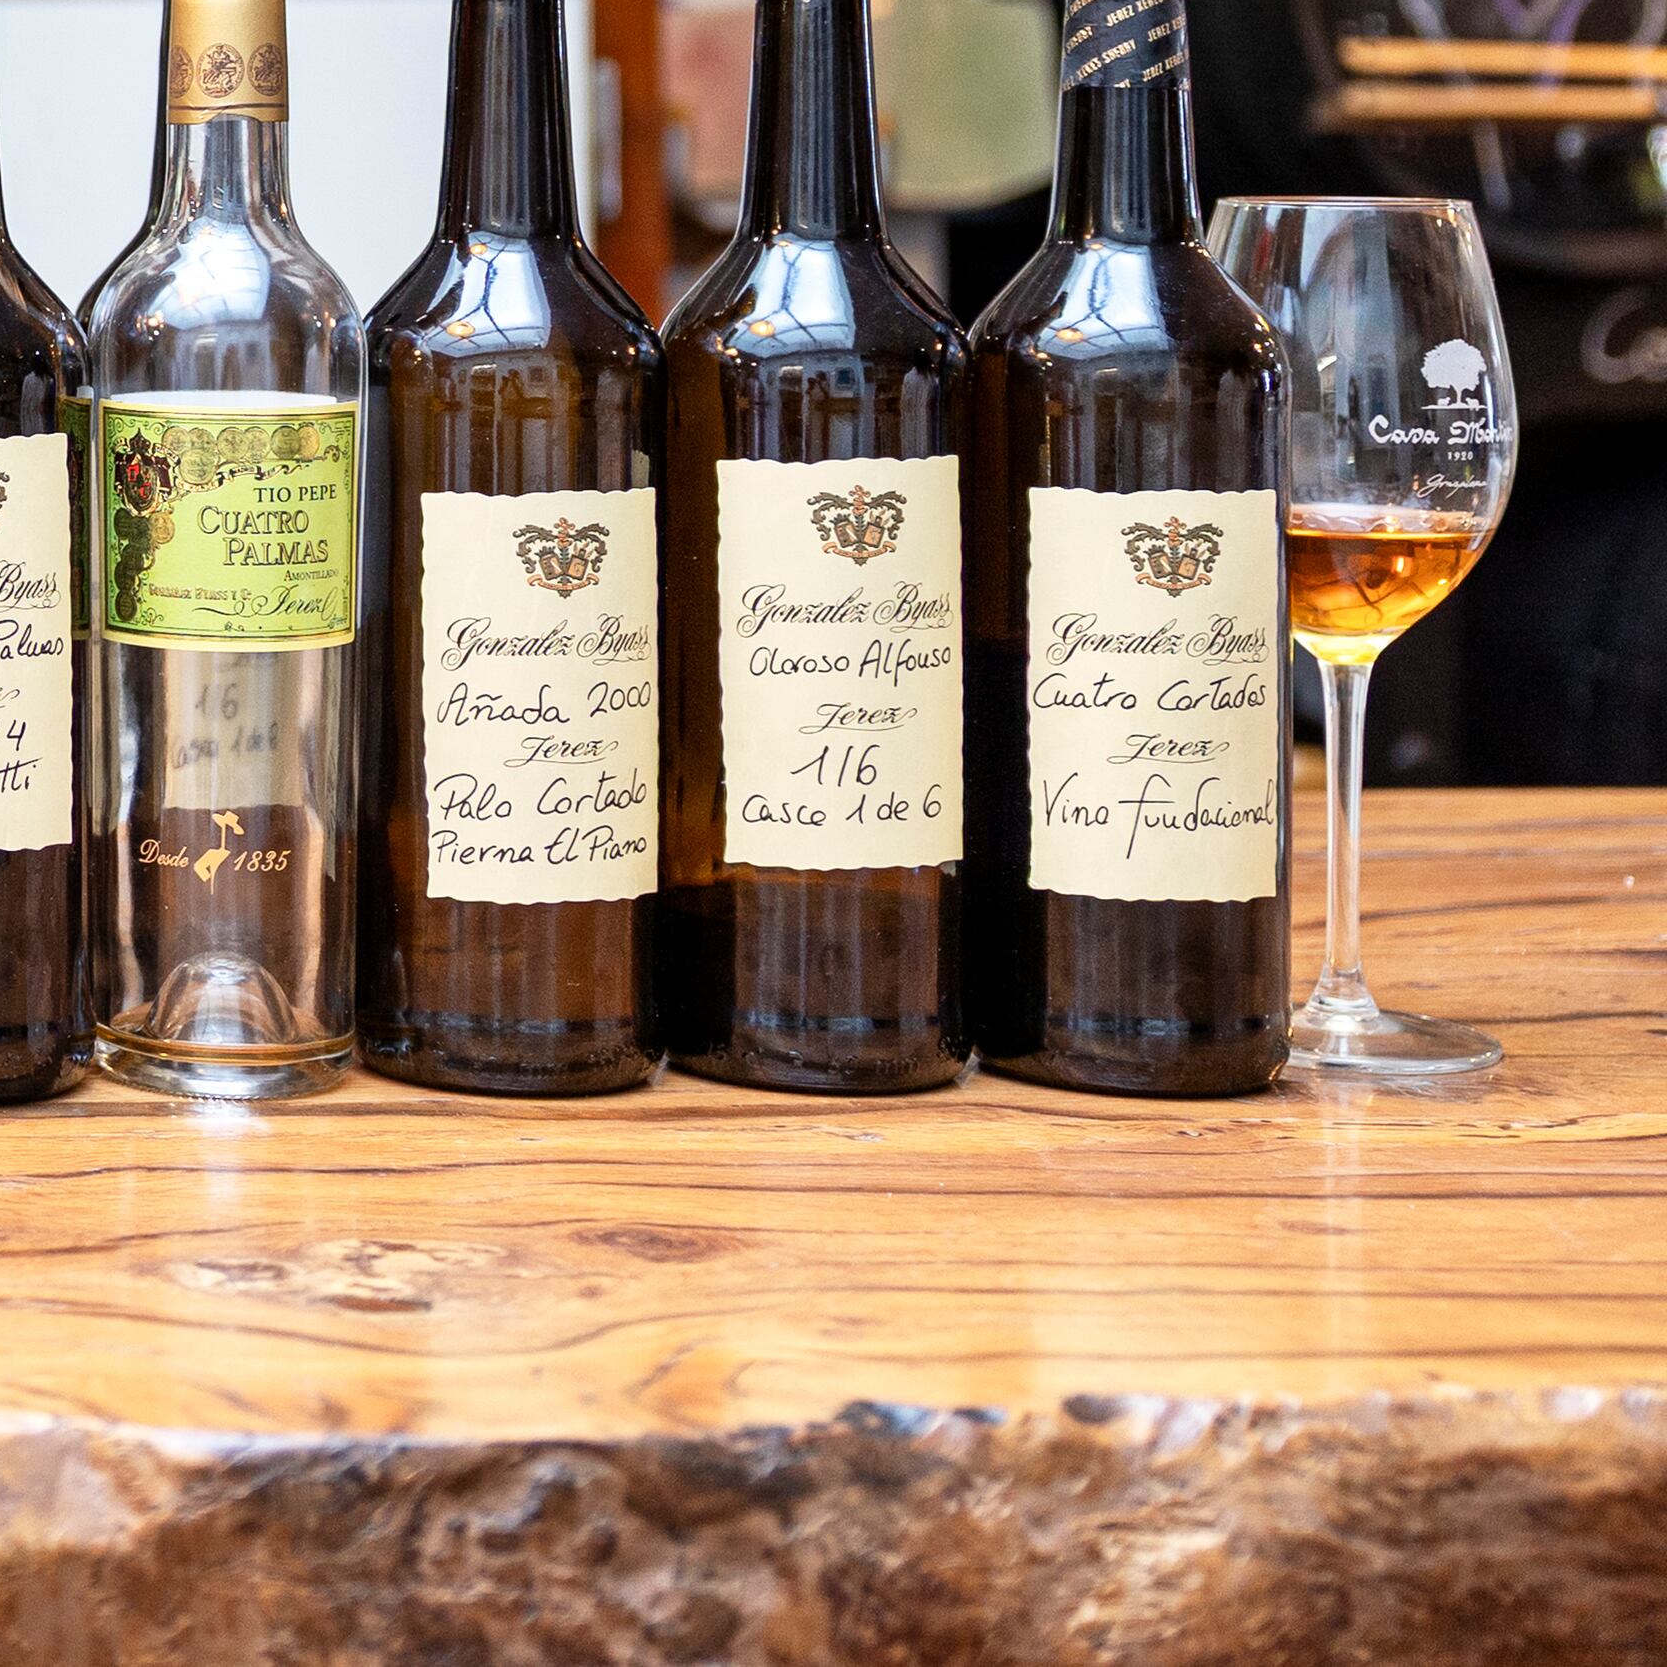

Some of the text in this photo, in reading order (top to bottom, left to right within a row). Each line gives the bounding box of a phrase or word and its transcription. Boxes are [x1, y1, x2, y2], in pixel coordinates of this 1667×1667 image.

[1106, 4, 1135, 27] JEREZ
[1367, 414, 1441, 445] Casa
[1446, 451, 1474, 461] 1920
[253, 484, 338, 503] TIO PEPE
[197, 505, 310, 535] CUATRO
[223, 536, 329, 566] PALMAS
[736, 580, 954, 638] Gonzalez Byass
[441, 613, 651, 671] Gonzalez Byass
[1046, 613, 1269, 666] Gonzalez Byass
[436, 680, 651, 727] Añada 2000
[1033, 672, 1267, 711] Cuatro Cortados
[799, 702, 918, 734] Jerez
[6, 719, 27, 752] 4
[503, 735, 619, 767] Jerez
[1107, 733, 1230, 764] Jerez
[433, 767, 648, 821] Palo Cortado
[845, 792, 867, 825] 1
[876, 790, 911, 822] de
[922, 784, 942, 819] 6
[1043, 771, 1110, 827] Vino
[139, 839, 291, 872] Desde 1835
[431, 829, 535, 865] Pierna
[543, 827, 580, 865] El
